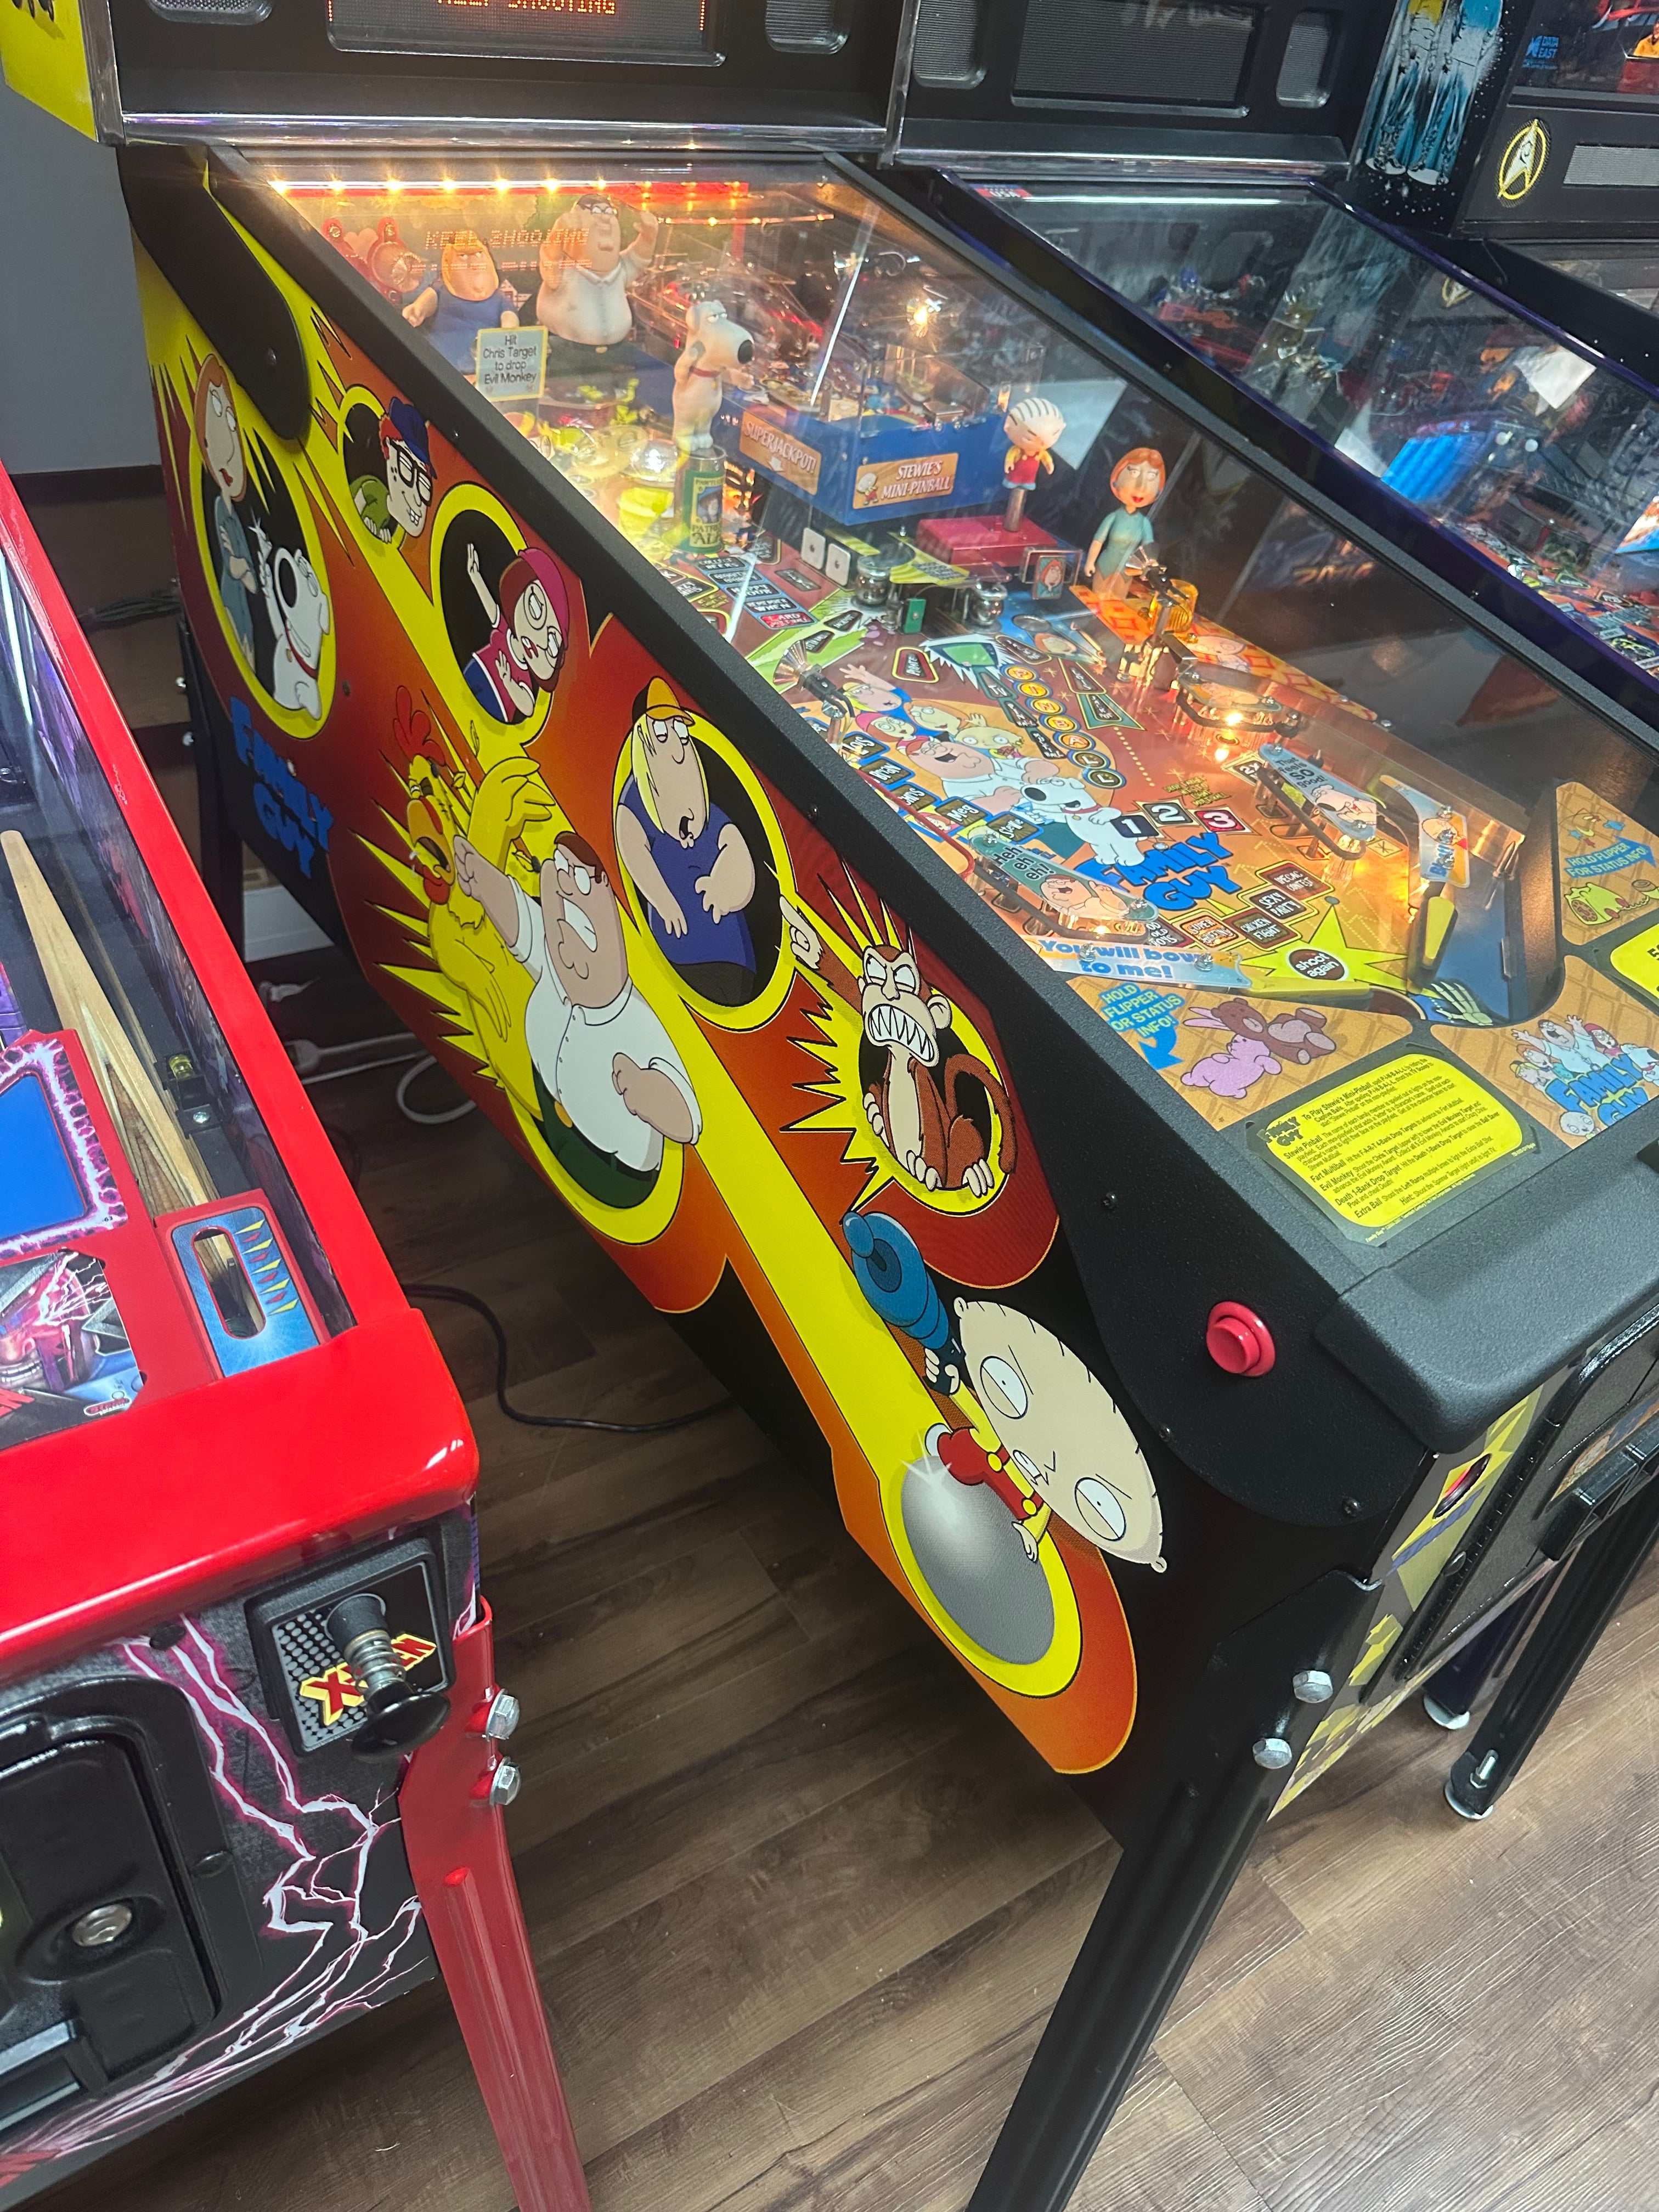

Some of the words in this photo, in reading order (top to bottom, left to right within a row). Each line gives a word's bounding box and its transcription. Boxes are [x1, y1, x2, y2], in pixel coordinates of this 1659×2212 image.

[1538, 48, 1557, 58] EAST
[504, 335, 517, 346] Hit
[483, 347, 505, 359] Chris
[507, 346, 537, 360] Target
[495, 361, 504, 371] to
[506, 360, 527, 373] drop
[484, 374, 499, 384] Evil
[501, 373, 537, 383] Monkey
[895, 460, 943, 481] STEWIE'S
[881, 476, 950, 500] MINI-PINBALL
[989, 685, 1007, 696] TV
[1275, 757, 1299, 766] That
[229, 696, 335, 851] FAMILY
[1289, 769, 1314, 780] SO
[1296, 775, 1328, 788] good!
[947, 804, 979, 822] Meg
[1151, 805, 1185, 822] 2
[1203, 812, 1235, 828] 3
[253, 781, 315, 879] GUY
[1121, 819, 1141, 834] 1
[992, 847, 1023, 866] Heh
[1074, 832, 1234, 893] FAMILY
[1567, 855, 1597, 866] HOLD
[1594, 842, 1631, 860] FLIPPER
[1567, 867, 1593, 877] FOR
[1590, 857, 1629, 873] STATUS
[1624, 845, 1648, 862] INFO!
[1014, 857, 1035, 870] eh
[1026, 863, 1055, 880] eh!
[1274, 871, 1304, 885] IPECAC
[1143, 865, 1243, 911] GUY
[1259, 891, 1285, 909] SEXY
[1270, 900, 1302, 917] PARTY
[1150, 928, 1169, 938] OLD
[1187, 919, 1217, 934] SUPER
[1240, 917, 1272, 933] CHICKEN
[1253, 925, 1282, 941] FIGHT
[1097, 946, 1139, 960] will
[1295, 952, 1331, 971] shoot
[1079, 961, 1112, 975] to
[1116, 963, 1173, 978] me!
[1307, 960, 1339, 978] again
[1102, 985, 1138, 1003] HOLD
[1103, 990, 1159, 1018] FLIPPER
[1131, 994, 1182, 1024] STATUS
[1137, 1017, 1175, 1038] INFO!
[1545, 1053, 1644, 1114] FAMILY
[1310, 1107, 1324, 1118] Play
[1321, 1095, 1344, 1110] Stewie's
[1597, 1087, 1649, 1127] GUY
[1283, 1145, 1304, 1159] Stewie
[1302, 1135, 1322, 1148] Pinball
[1310, 1172, 1324, 1182] Fart
[1322, 1159, 1346, 1175] Multiball
[1390, 1130, 1403, 1138] Drop
[1400, 1121, 1418, 1134] Targets
[1319, 1181, 1333, 1190] Evil
[1330, 1169, 1355, 1186] Monkey
[1352, 1162, 1367, 1172] Shoot
[1372, 1152, 1386, 1161] Chris
[1383, 1144, 1401, 1156] Target
[1334, 1192, 1353, 1205] Death
[1351, 1181, 1372, 1195] 1-Bank
[1369, 1173, 1386, 1186] Drop
[1383, 1164, 1403, 1178] Target
[1413, 1150, 1427, 1160] Death
[1438, 1137, 1452, 1147] Drop
[1448, 1130, 1464, 1142] Target
[1347, 1198, 1360, 1207] Post
[1358, 1193, 1369, 1201] and
[1367, 1186, 1380, 1196] cheat
[1378, 1178, 1394, 1189] Death!
[1399, 1193, 1415, 1204] Hint:
[1413, 1187, 1427, 1197] Shoot
[1446, 1167, 1461, 1178] Target
[1353, 1205, 1372, 1217] Extra
[1369, 1198, 1383, 1208] Ball
[1381, 1190, 1396, 1201] Shoot
[1409, 1174, 1425, 1185] Ramp
